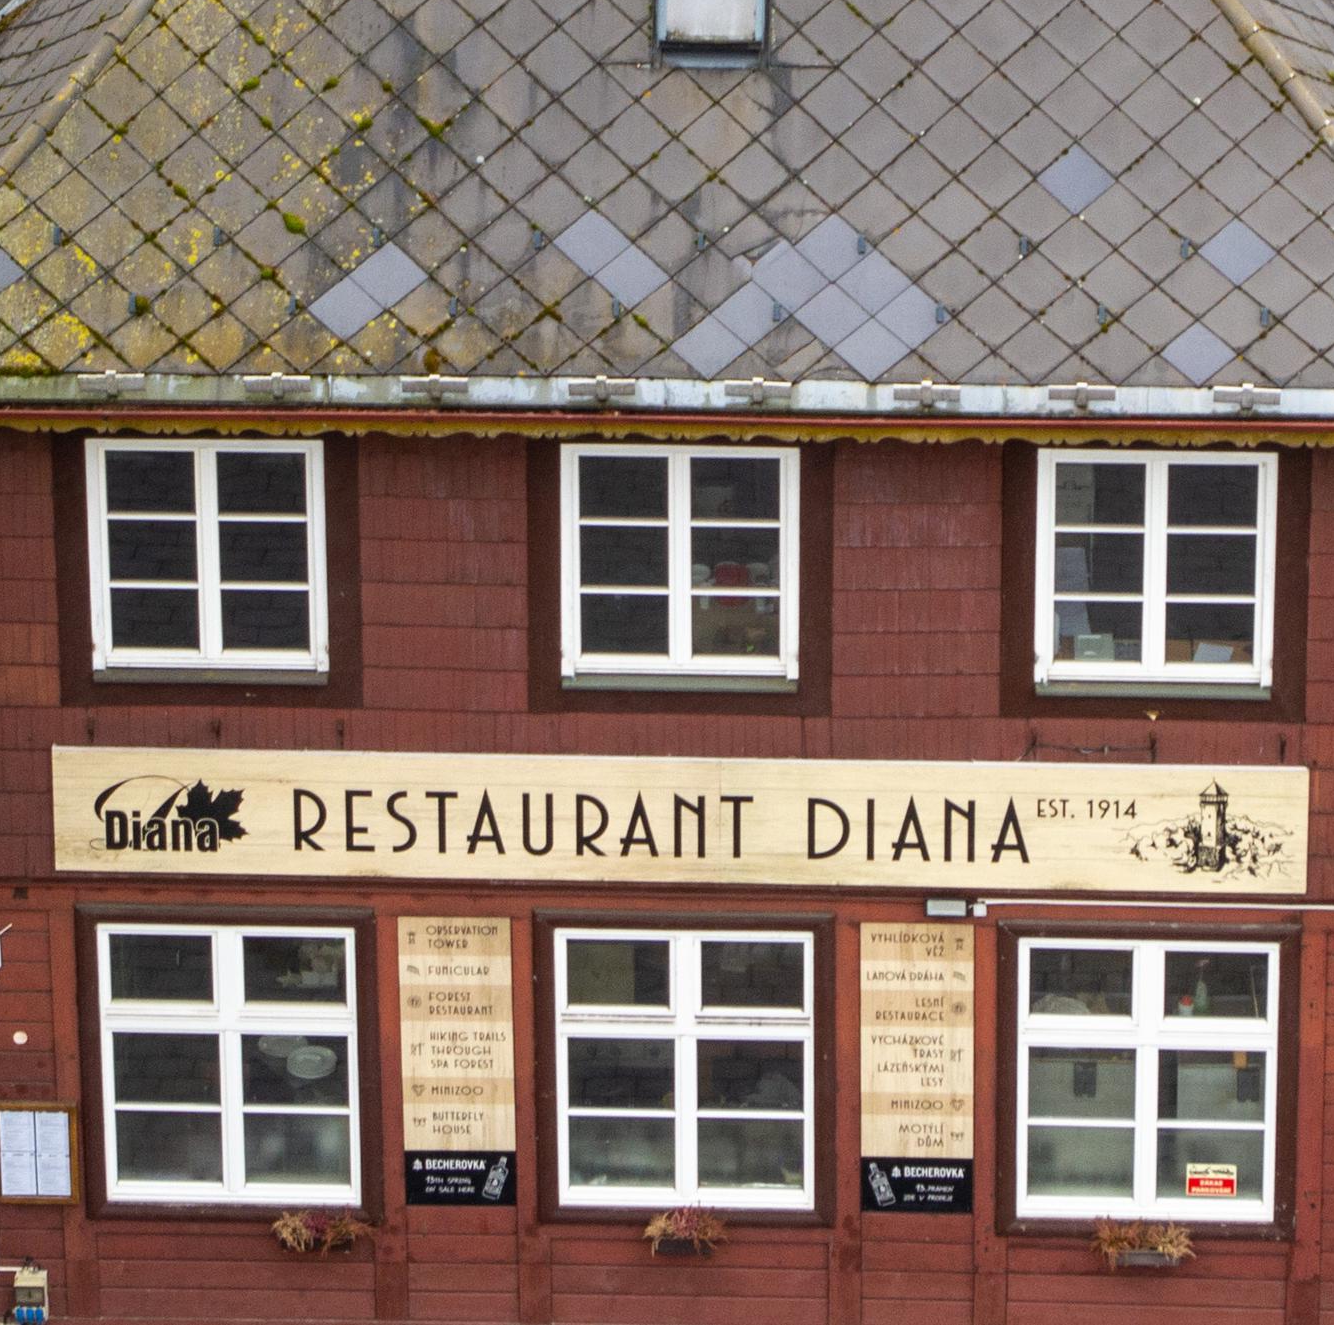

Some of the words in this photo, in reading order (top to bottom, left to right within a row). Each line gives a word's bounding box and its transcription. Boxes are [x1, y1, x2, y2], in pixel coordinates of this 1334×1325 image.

[1036, 798, 1075, 819] EST.
[1087, 799, 1138, 820] 1914
[293, 787, 754, 859] RESTAURANT
[807, 795, 1030, 863] DIANA
[105, 810, 219, 852] Diana
[425, 925, 498, 936] OBSERVATION
[870, 931, 945, 943] VYHLÍDKOVÁ
[428, 938, 469, 949] TOWER
[428, 965, 490, 976] FUNICULAR
[866, 969, 906, 981] LANOVÁ
[909, 969, 945, 981] DRÁHA
[428, 991, 471, 1002] FOREST
[915, 996, 945, 1008] LESNÍ
[429, 1005, 493, 1016] RESTAURANT
[875, 1010, 944, 1021] RESTAURACE
[429, 1031, 468, 1042] HIKING
[473, 1031, 507, 1042] TRAILS
[871, 1034, 944, 1045] VYCHÁZKOVÉ
[431, 1045, 492, 1056] THROUGH
[913, 1049, 944, 1058] TRASY
[430, 1059, 449, 1069] SPA
[454, 1059, 494, 1069] FOREST
[920, 1077, 944, 1087] LESY
[431, 1085, 484, 1096] MINIZOO
[890, 1100, 944, 1110] MINIZOO
[432, 1111, 484, 1122] BUTTERFLY
[432, 1125, 472, 1135] HOUSE
[898, 1123, 944, 1135] MOTÝLÍ
[425, 1159, 485, 1170] BECHEROVKA
[904, 1166, 964, 1178] BECHEROVKA
